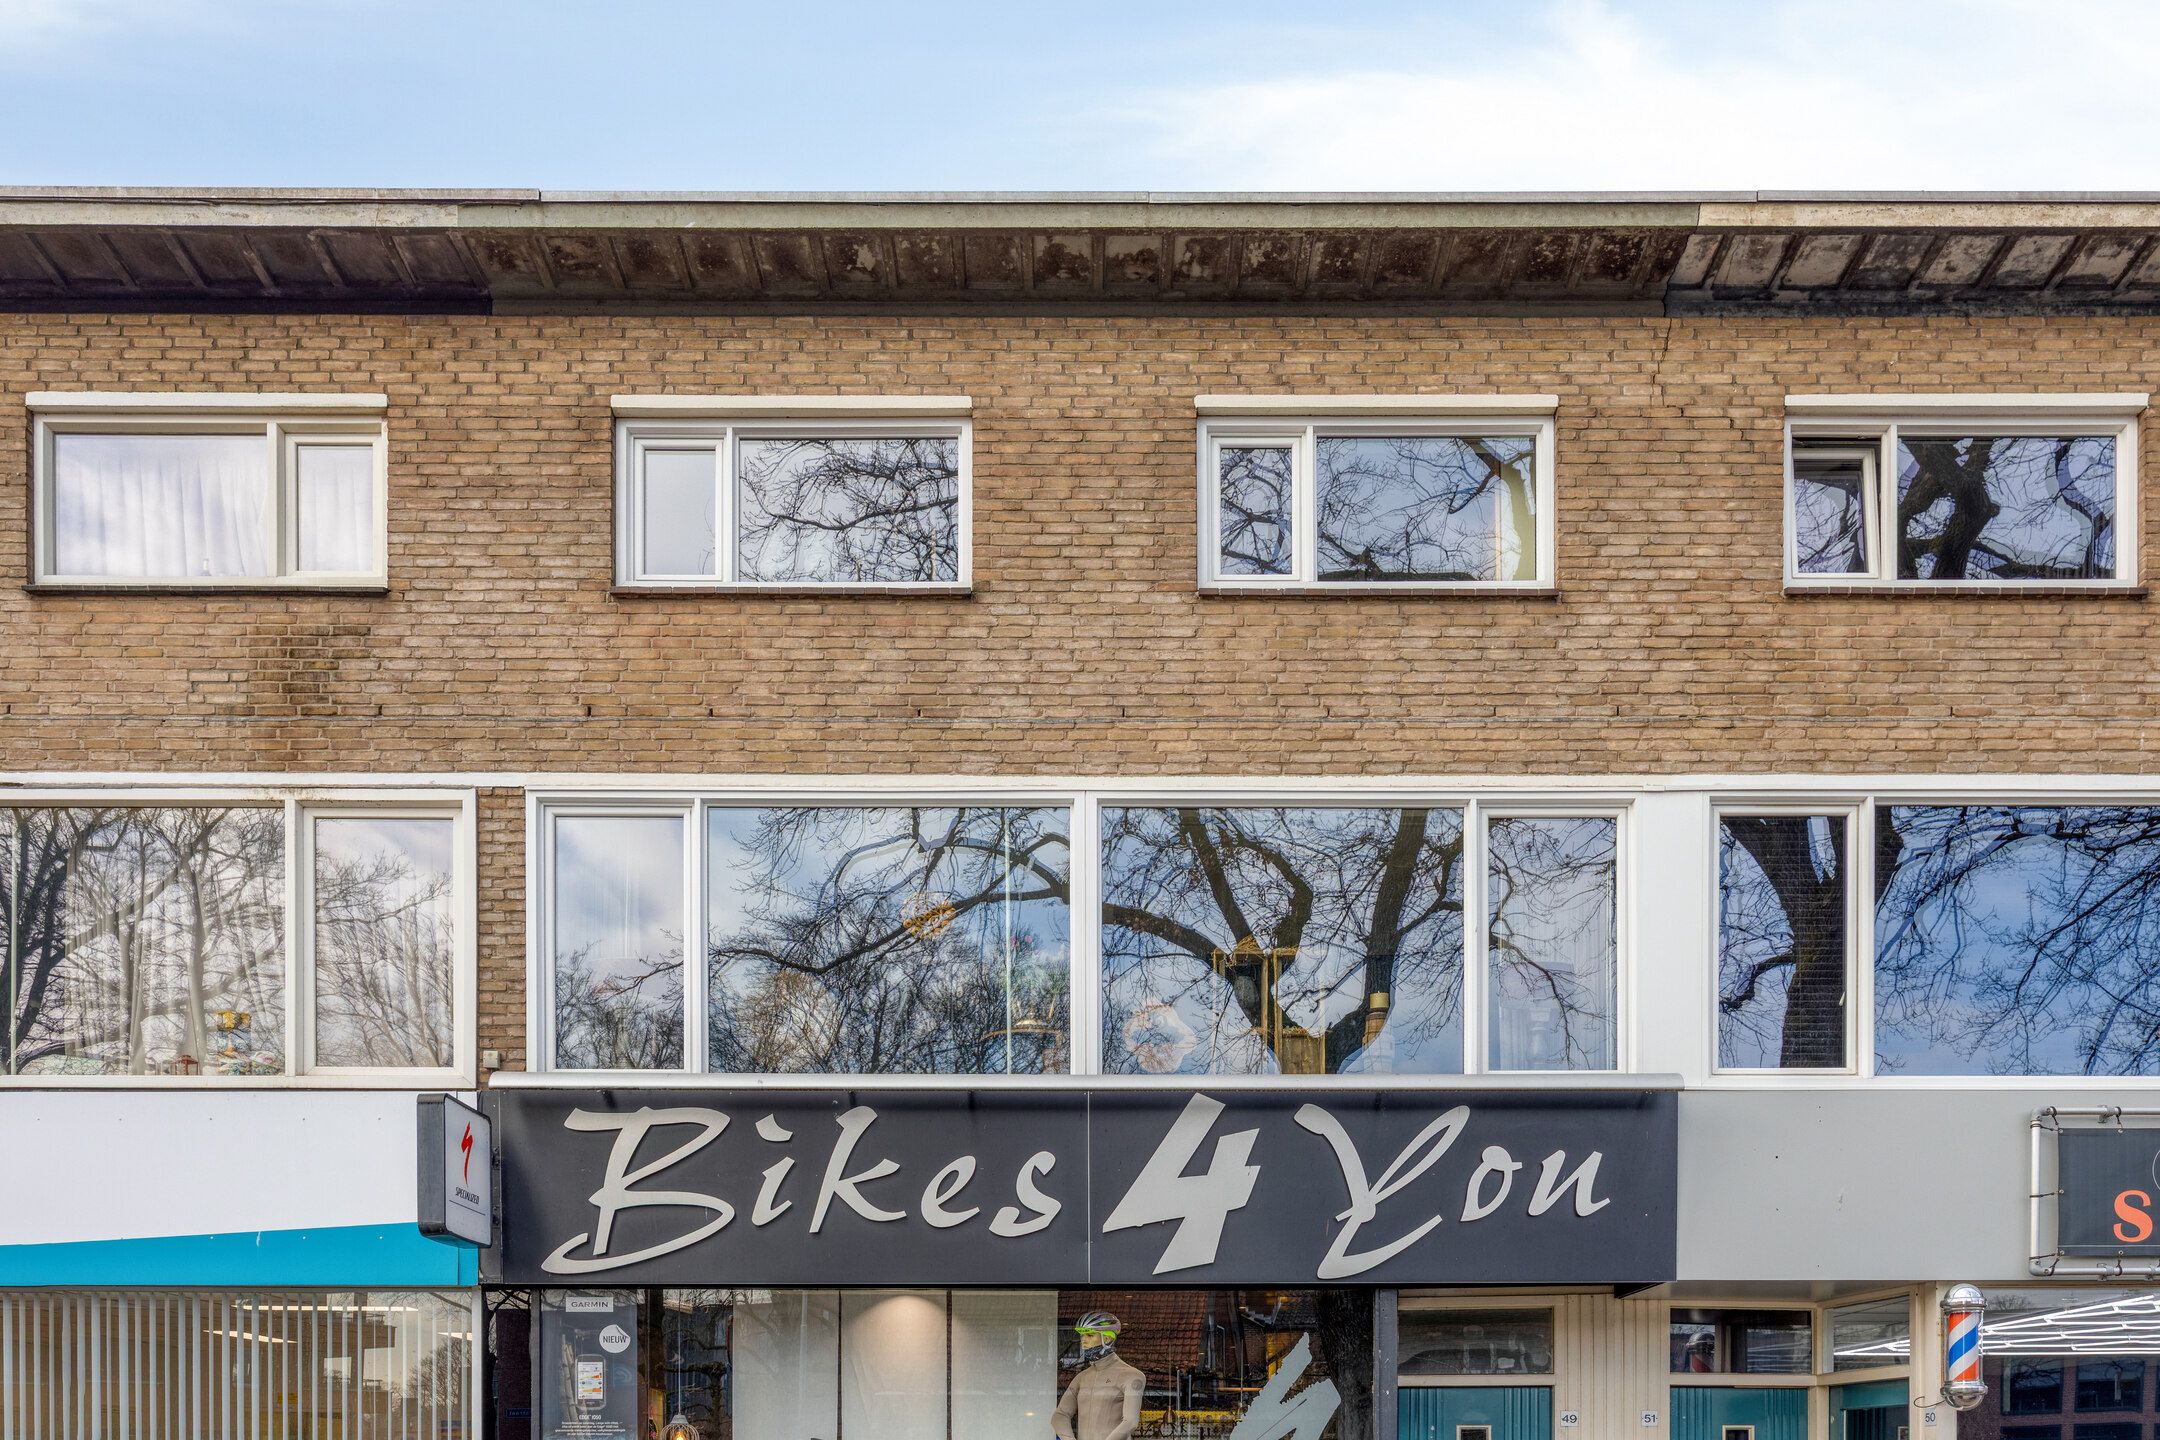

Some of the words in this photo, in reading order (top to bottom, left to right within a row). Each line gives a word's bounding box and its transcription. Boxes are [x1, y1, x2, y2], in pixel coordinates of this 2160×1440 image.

[541, 1105, 1062, 1275] Bikes
[1102, 1095, 1262, 1276] 4
[1294, 1104, 1611, 1279] You
[602, 1335, 627, 1344] NIEUW
[1561, 1414, 1578, 1424] 49
[1644, 1414, 1656, 1423] 51
[1924, 1412, 1936, 1423] 50
